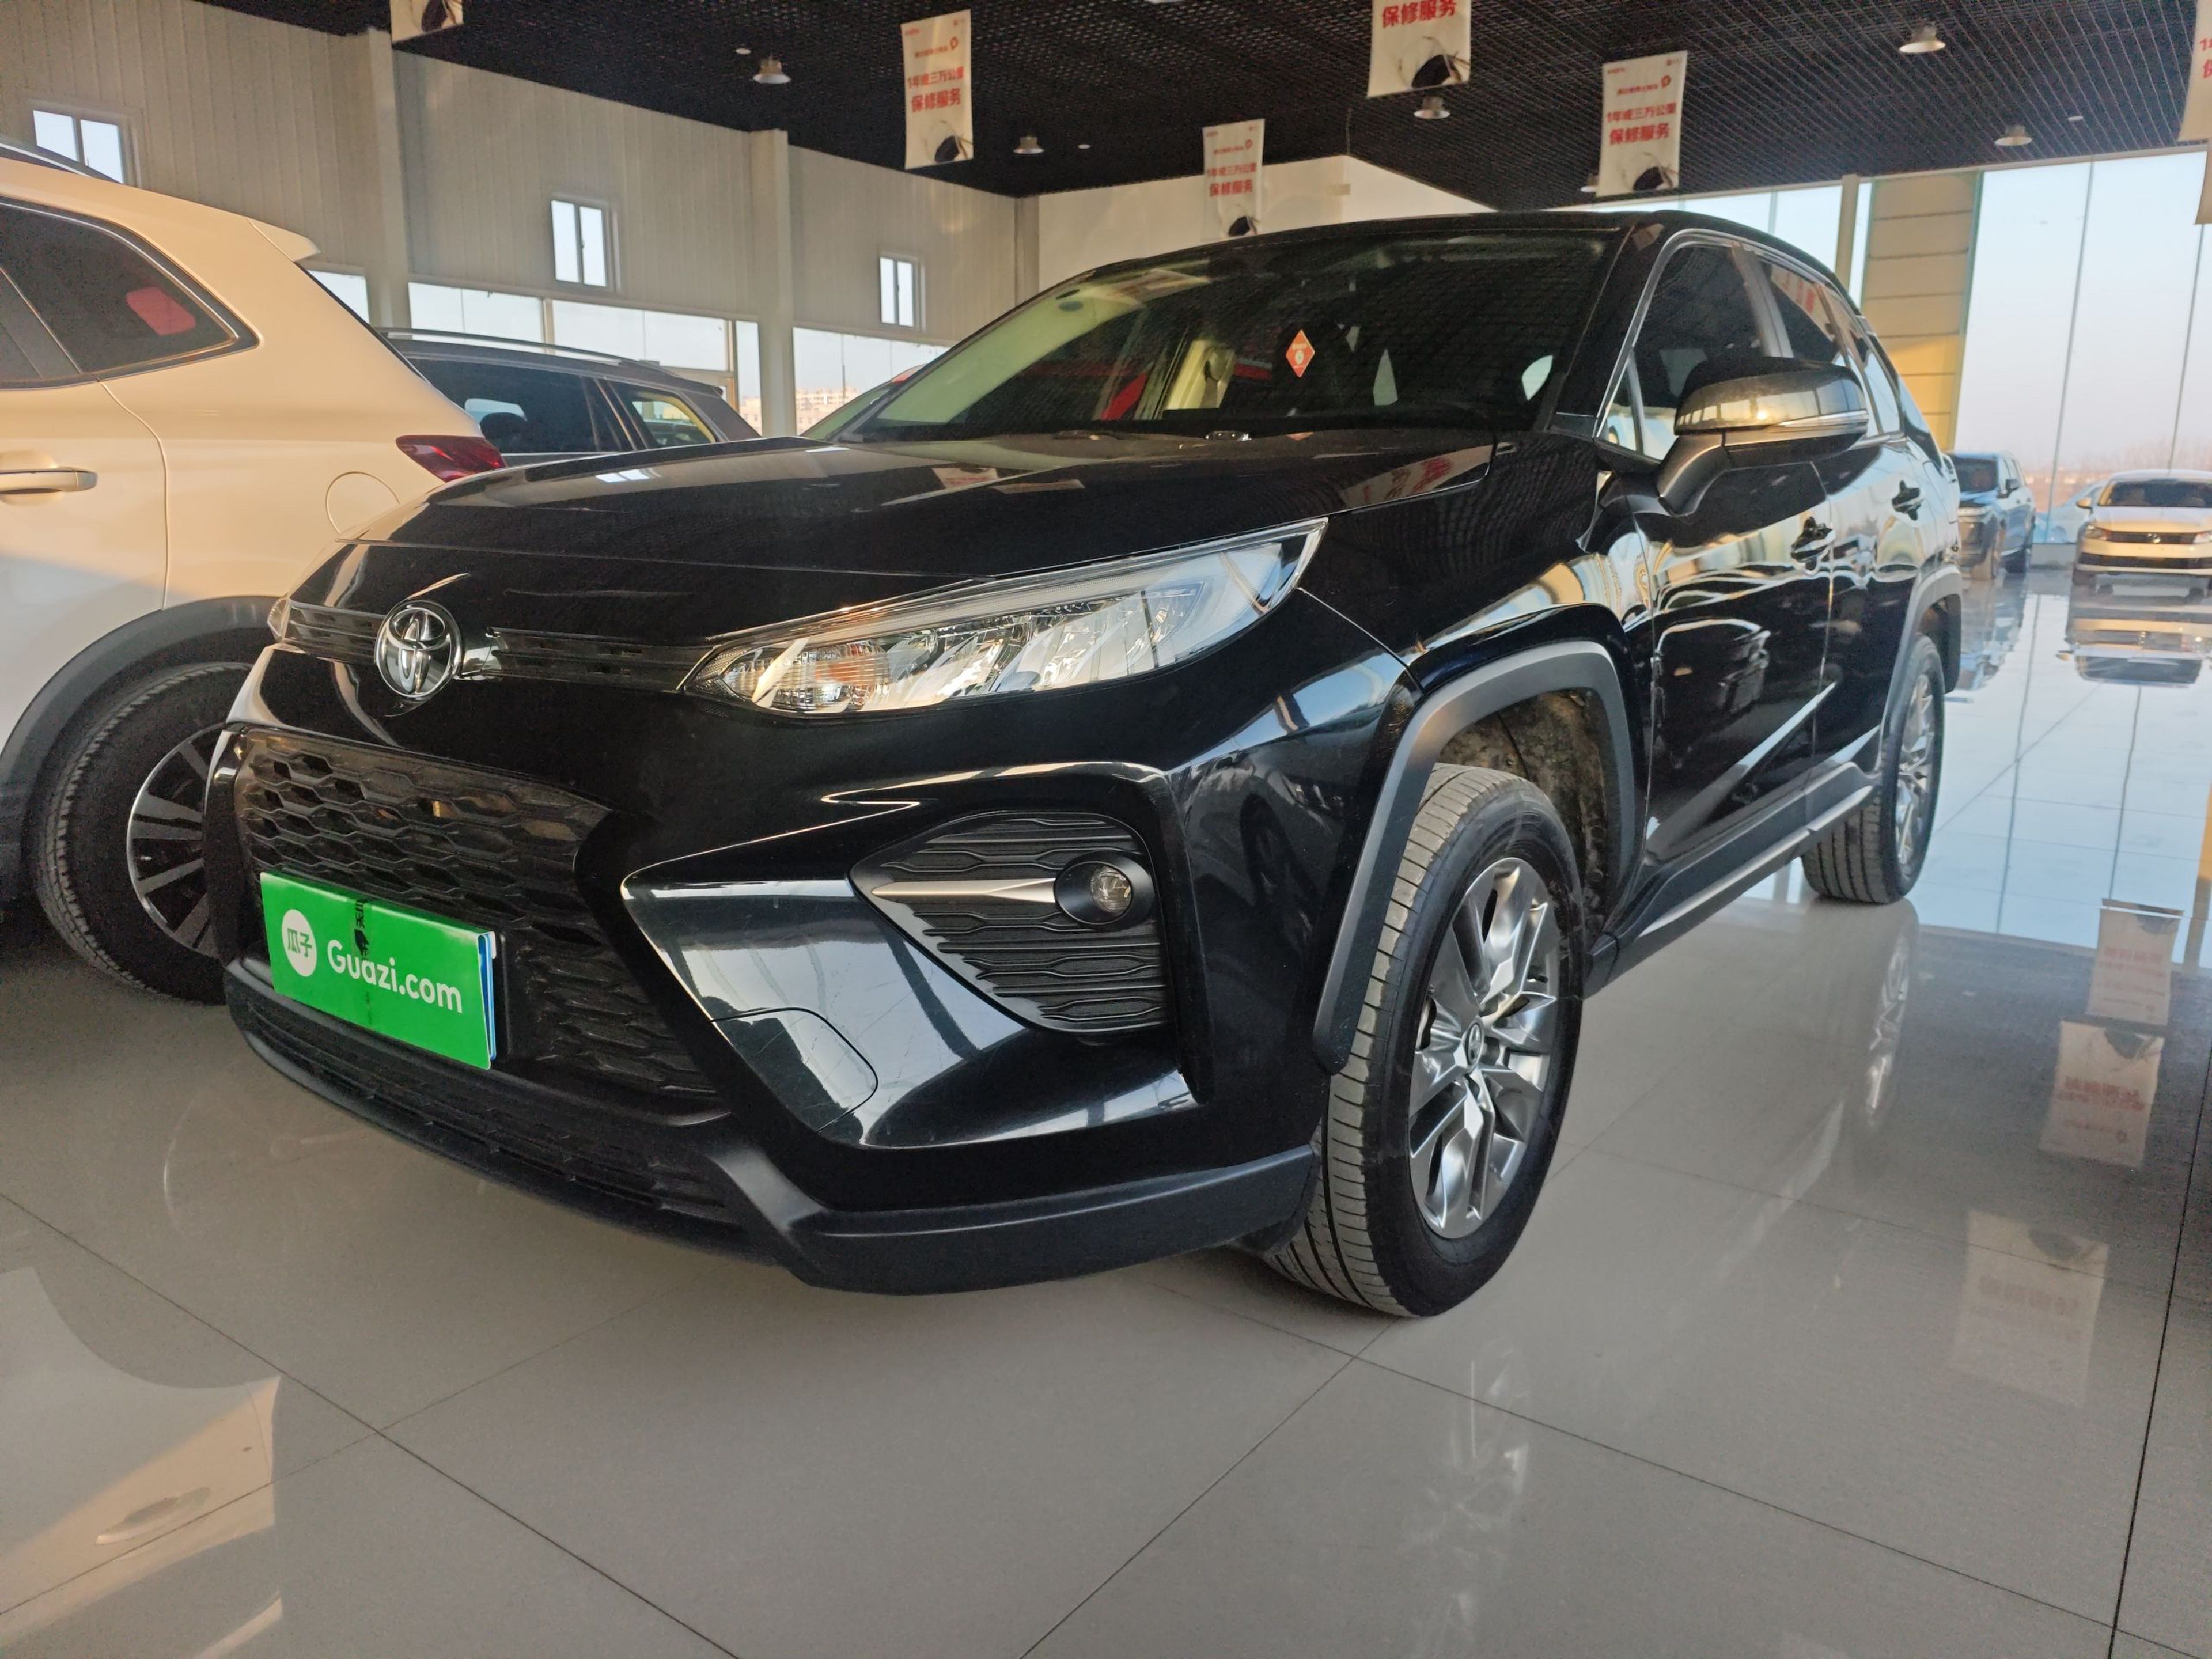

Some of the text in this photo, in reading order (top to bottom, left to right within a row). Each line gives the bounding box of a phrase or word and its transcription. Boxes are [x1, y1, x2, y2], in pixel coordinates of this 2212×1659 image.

[1382, 0, 1456, 28] 保修服务
[287, 928, 313, 957] 瓜子
[327, 939, 463, 1014] Guazi.com
